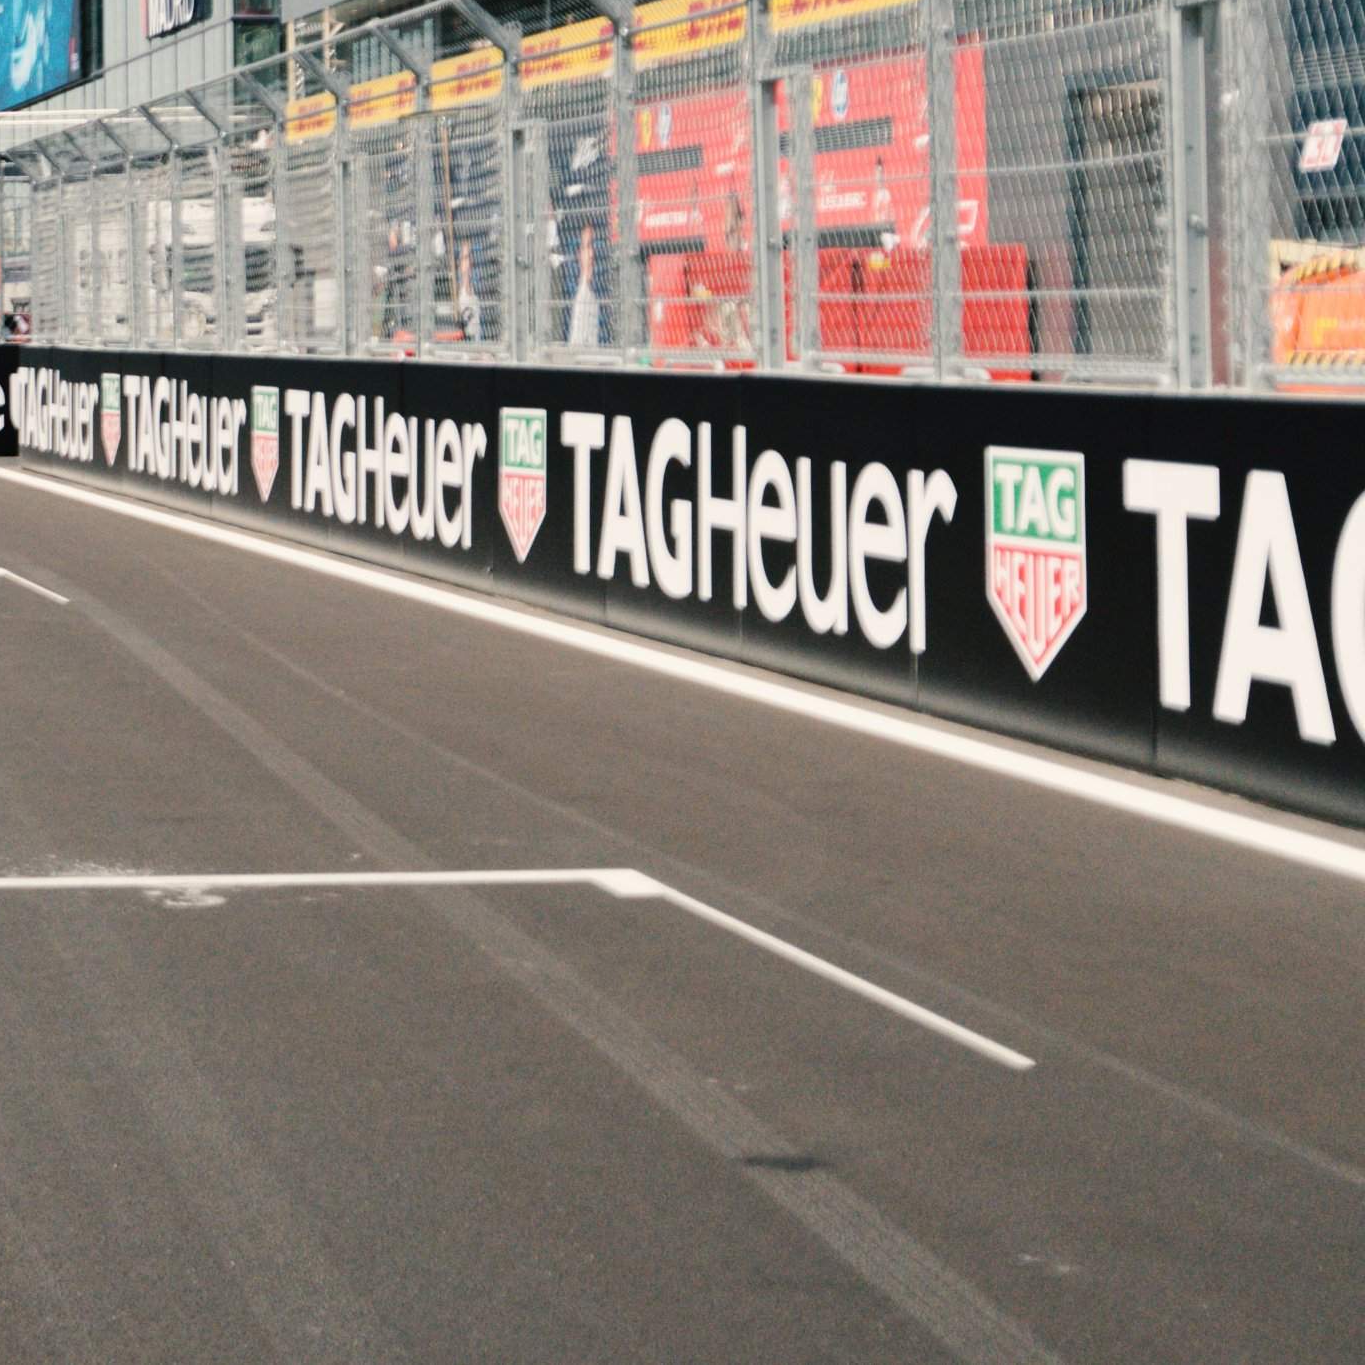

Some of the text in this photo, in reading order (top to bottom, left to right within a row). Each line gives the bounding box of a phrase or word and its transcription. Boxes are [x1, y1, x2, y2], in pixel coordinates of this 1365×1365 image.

[122, 374, 246, 495] TAGHeuer
[285, 389, 487, 549] TAGHeuer
[506, 418, 542, 467] TAG
[504, 477, 543, 547] HEUER
[561, 411, 957, 654] TAGHeuer
[994, 463, 1076, 539] TAG
[995, 549, 1080, 657] HEUER
